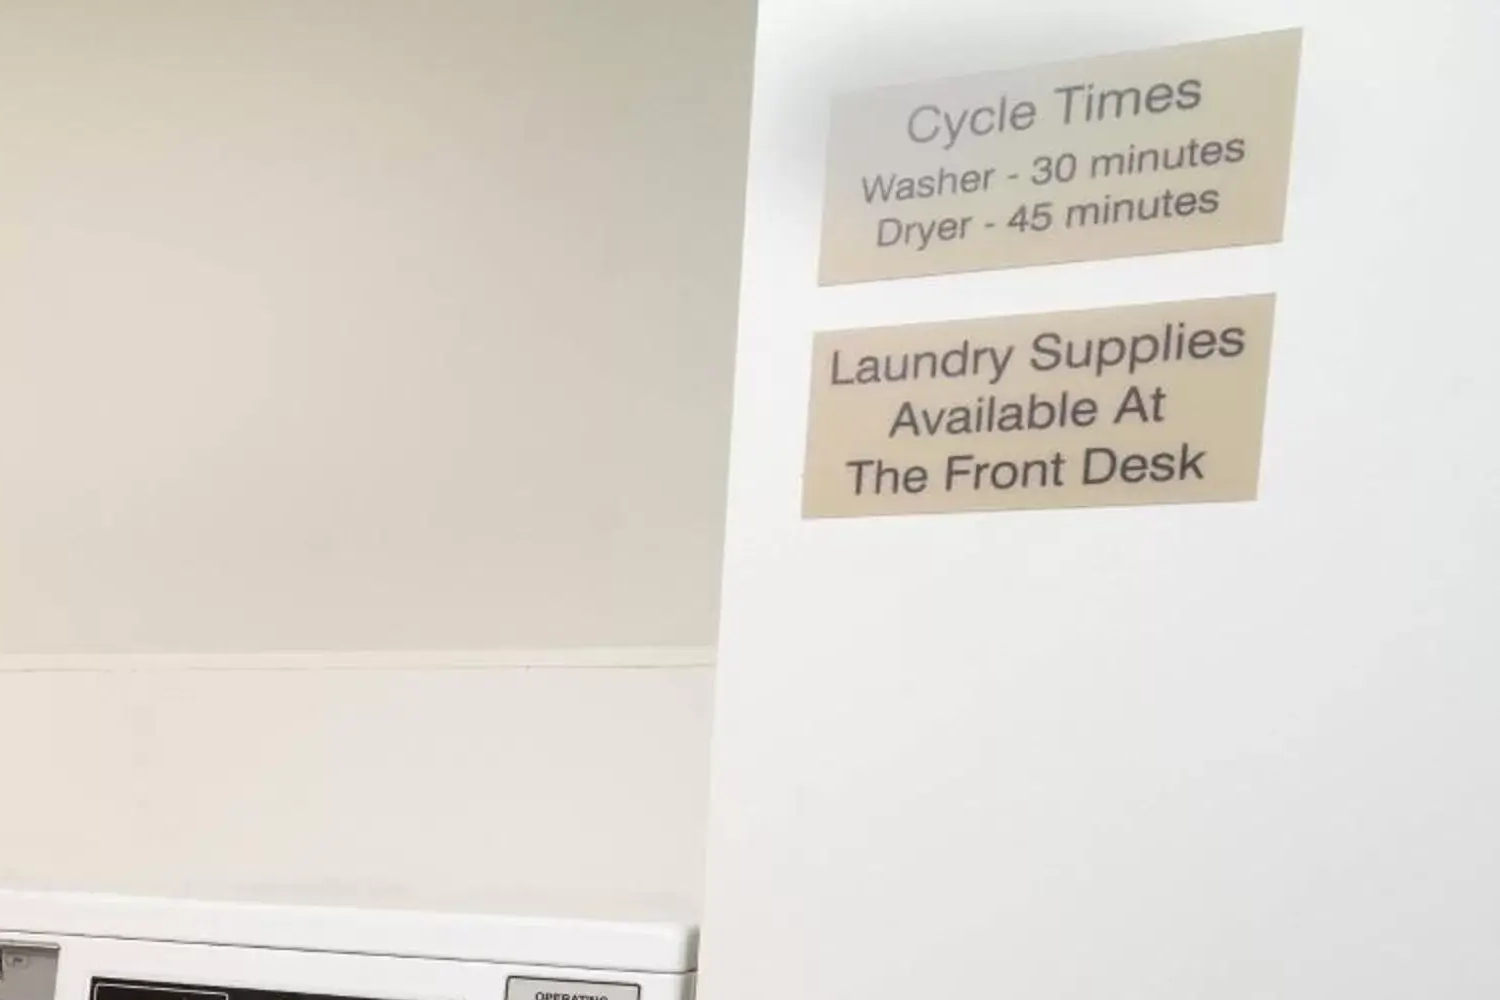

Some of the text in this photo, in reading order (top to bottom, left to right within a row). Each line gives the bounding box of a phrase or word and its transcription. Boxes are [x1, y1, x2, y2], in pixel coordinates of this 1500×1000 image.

[907, 77, 1204, 152] Cycle Times
[861, 163, 995, 204] Washer
[1030, 152, 1077, 186] 30
[1091, 135, 1246, 178] minutes
[876, 211, 973, 251] Dryer
[1007, 201, 1053, 234] 45
[1065, 187, 1220, 229] minutes
[830, 321, 1246, 387] Laundry Supplies
[888, 384, 1167, 439] Available At
[846, 442, 1207, 496] The Front Desk
